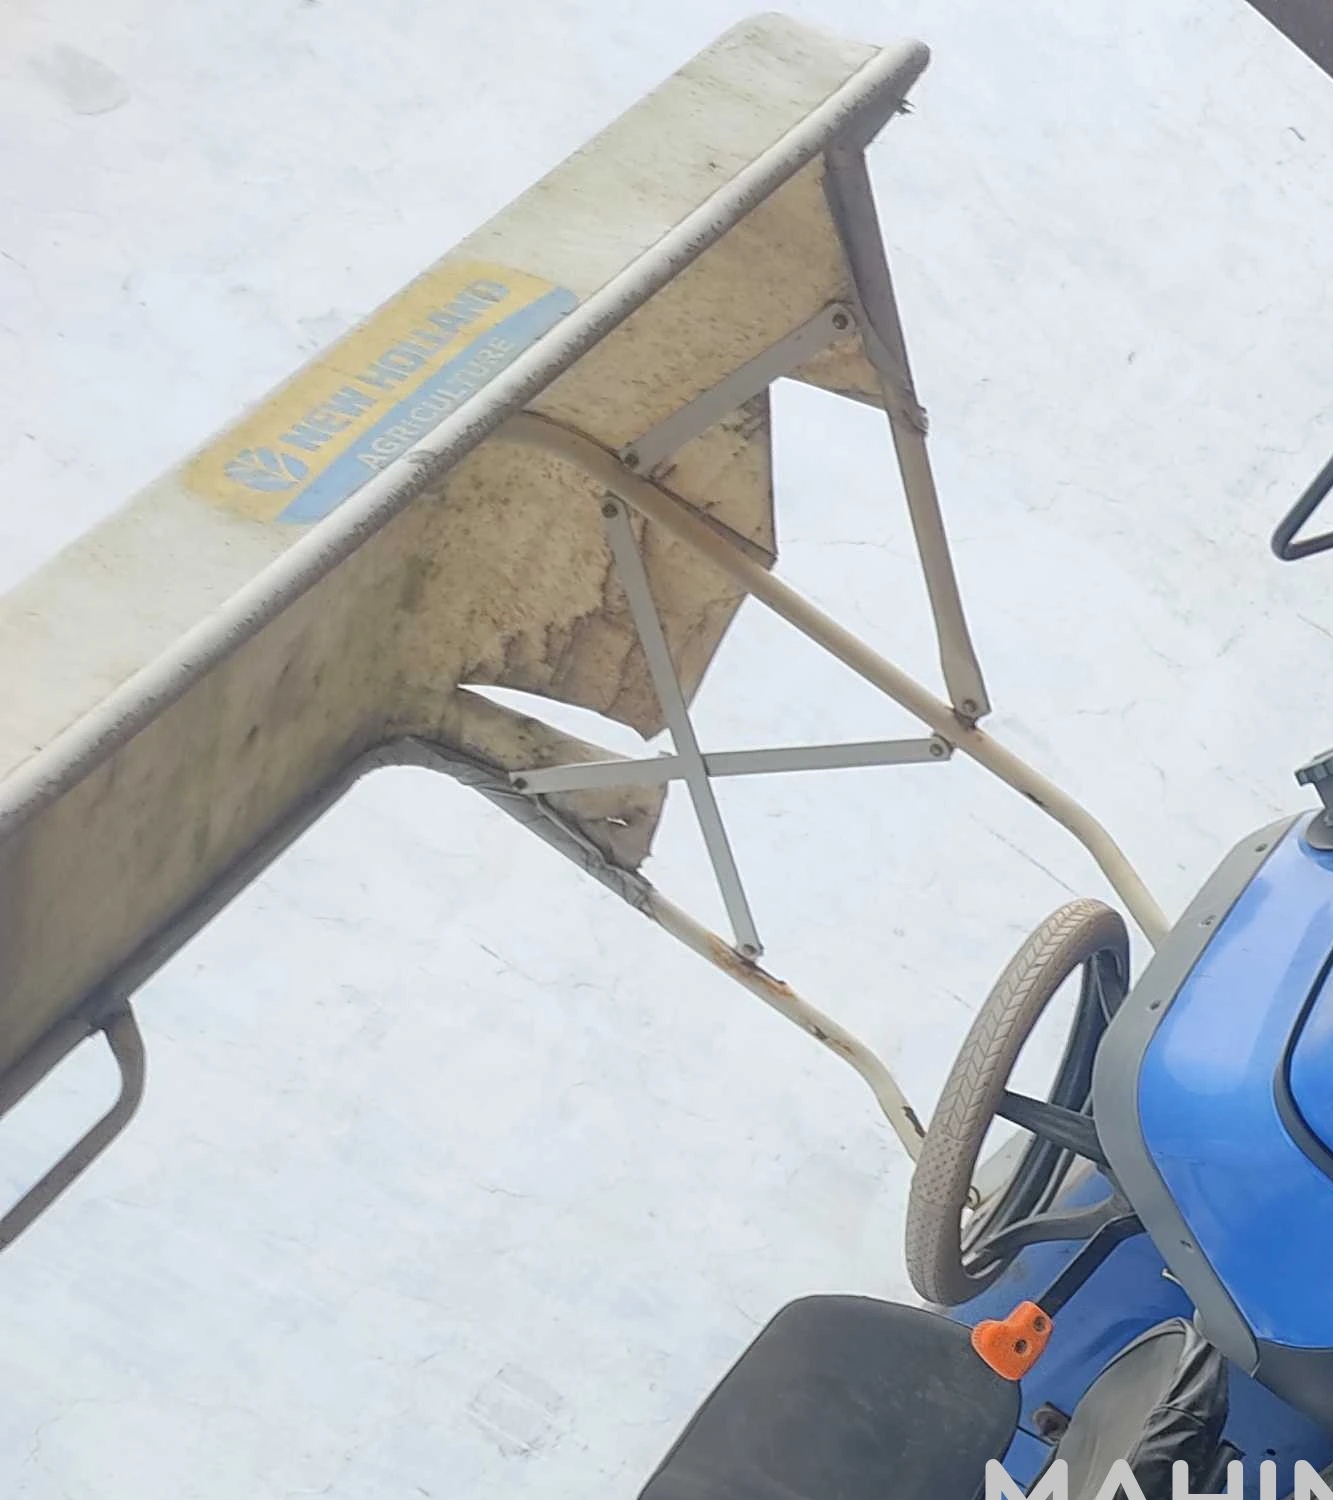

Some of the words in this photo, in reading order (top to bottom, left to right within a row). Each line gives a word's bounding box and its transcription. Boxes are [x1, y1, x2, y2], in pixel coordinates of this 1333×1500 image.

[279, 385, 378, 452] NEW
[356, 278, 510, 391] HOLLAND
[355, 337, 516, 473] AGRICULTURE
